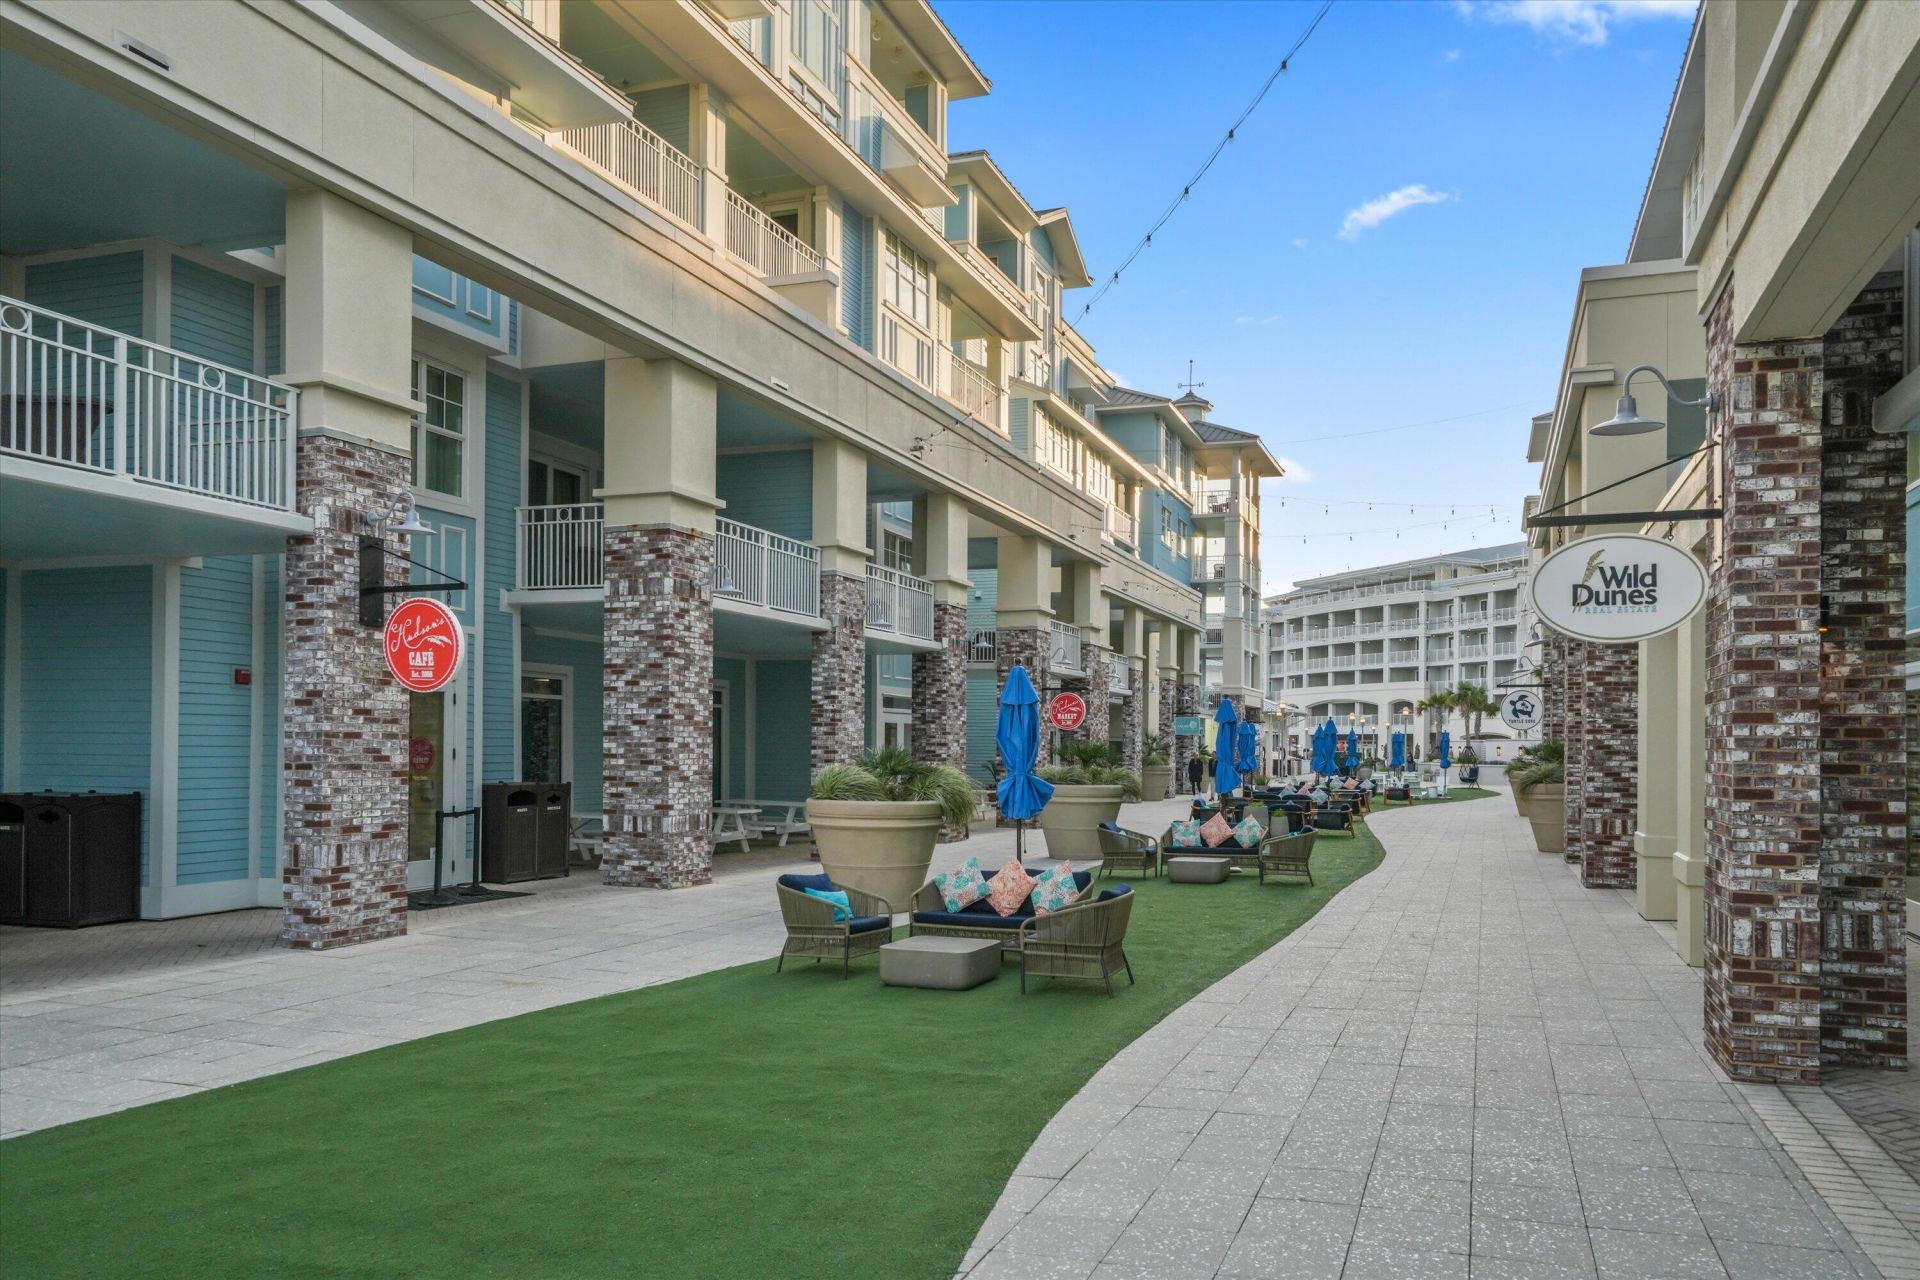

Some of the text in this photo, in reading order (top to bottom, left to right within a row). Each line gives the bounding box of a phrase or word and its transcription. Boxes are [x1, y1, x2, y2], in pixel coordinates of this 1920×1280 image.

[1598, 563, 1657, 589] Wild
[1572, 583, 1658, 606] Dunes
[1584, 605, 1658, 615] REAL ESTATE
[390, 615, 445, 653] Hudson's
[408, 648, 434, 667] CAFÉ
